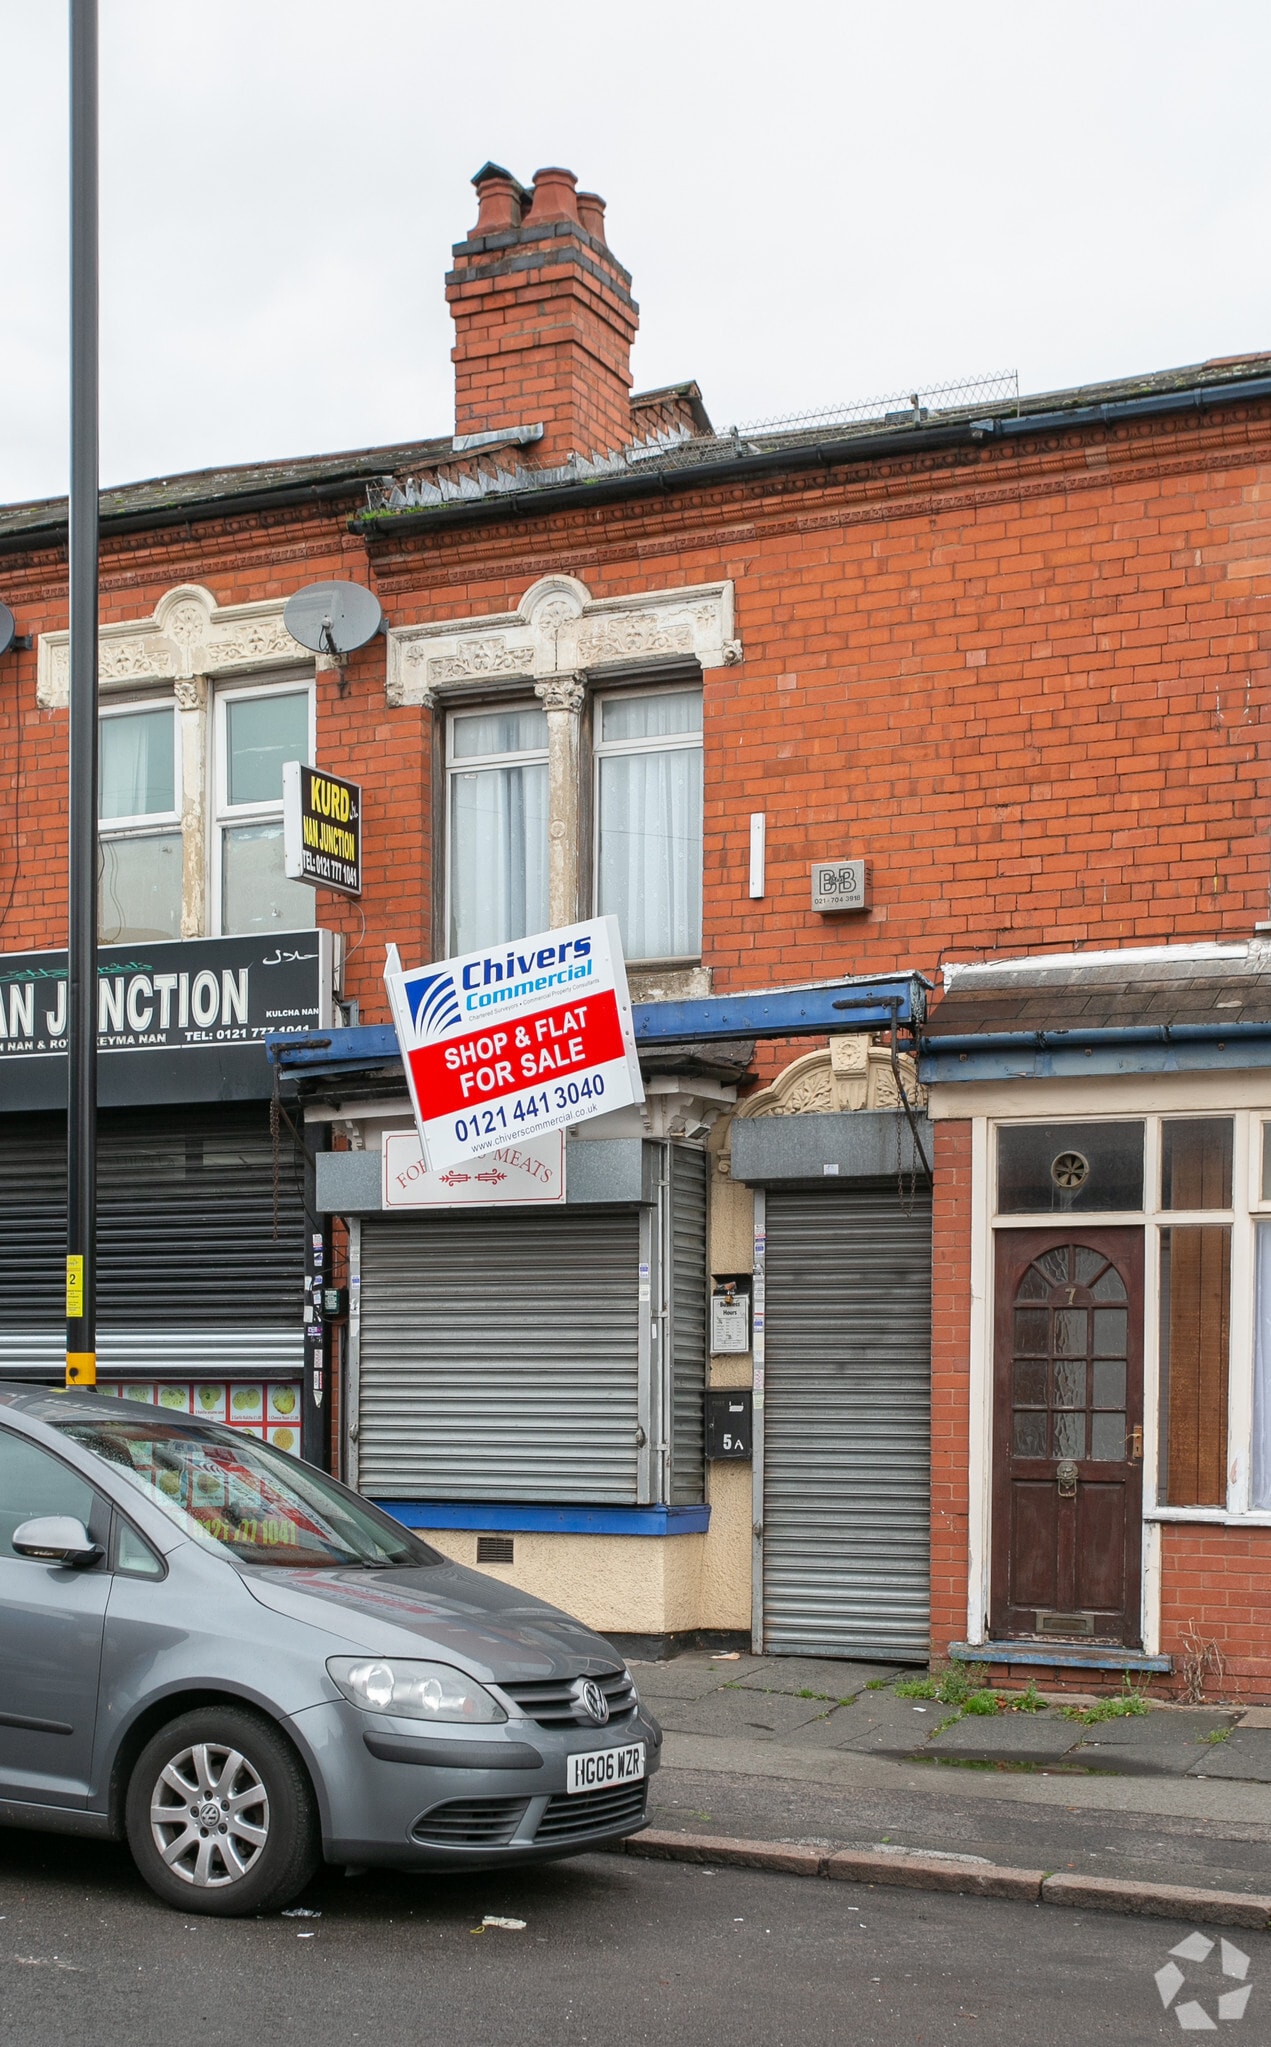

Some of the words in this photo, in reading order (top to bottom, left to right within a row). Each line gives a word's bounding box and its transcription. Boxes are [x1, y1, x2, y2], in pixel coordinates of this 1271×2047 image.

[311, 775, 350, 823] KURD
[303, 815, 319, 848] NAN
[319, 822, 355, 861] JUNCTION
[302, 849, 316, 872] TEL:
[316, 854, 330, 878] 0121
[330, 860, 342, 881] 777
[343, 864, 357, 887] 1041
[462, 936, 592, 991] Chivers
[466, 959, 593, 1011] Commercial
[46, 968, 249, 1037] JNCTION
[266, 1009, 300, 1018] KULCHA
[301, 1008, 319, 1016] NAN
[469, 1010, 494, 1022] Chartered
[494, 1003, 519, 1015] Surveyors
[523, 993, 552, 1006] Commercial
[551, 986, 572, 999] Property
[572, 978, 600, 991] Consultants
[7, 1041, 34, 1052] NAN
[37, 1040, 47, 1050] &
[138, 1033, 167, 1044] NAN
[185, 1031, 213, 1042] TEL:
[216, 1028, 247, 1040] 0121
[444, 1032, 508, 1070] SHOP
[515, 1026, 531, 1048] &
[535, 1006, 588, 1042] FLAT
[460, 1061, 515, 1098] FOR
[520, 1036, 586, 1077] SALE
[455, 1106, 507, 1142] 0121
[513, 1092, 550, 1121] 441
[554, 1074, 605, 1109] 3040
[471, 1103, 598, 1153] www.chiverscommercial.co.uk
[492, 1148, 553, 1183] MEATS
[69, 1274, 76, 1285] 2
[1064, 1287, 1076, 1305] 7
[262, 1519, 297, 1545] 1041
[575, 1753, 614, 1787] HG06
[618, 1748, 640, 1779] WZR
